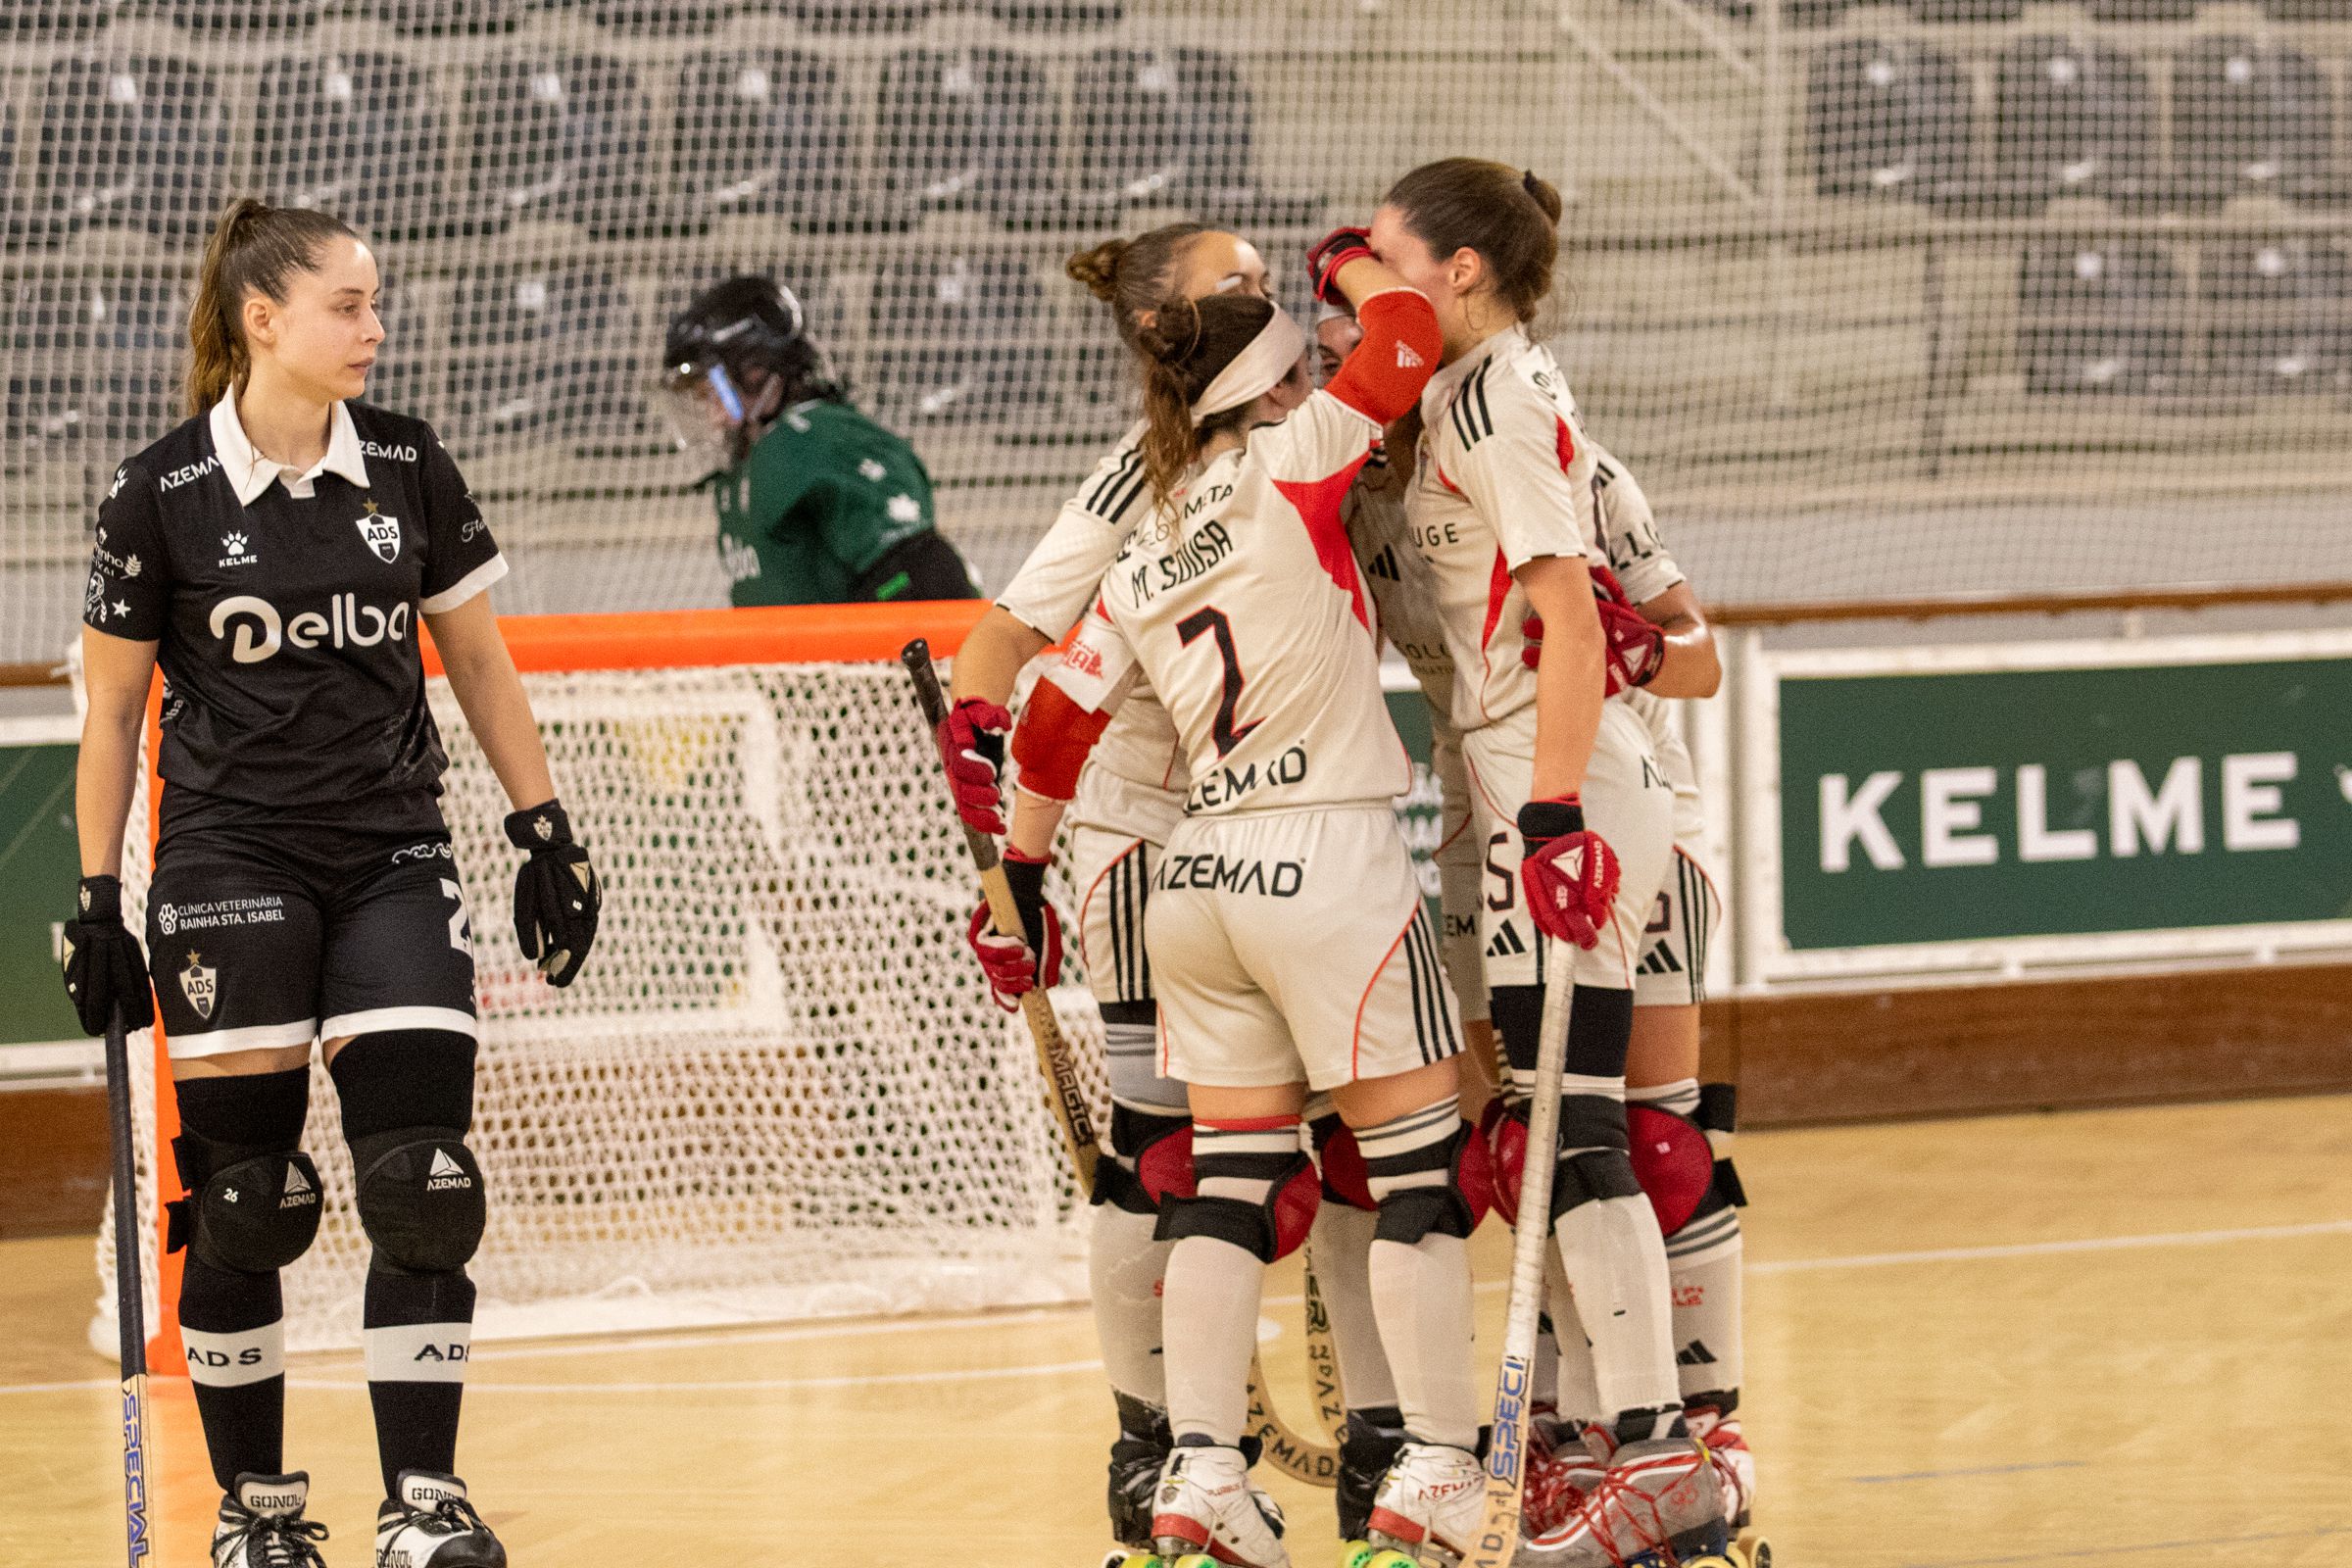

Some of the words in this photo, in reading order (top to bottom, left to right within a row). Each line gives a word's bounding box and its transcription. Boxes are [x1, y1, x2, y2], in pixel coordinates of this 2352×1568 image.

[367, 526, 398, 542] ADS
[219, 555, 258, 568] KELME
[1158, 519, 1233, 591] SOUSA
[1175, 605, 1268, 761] 2
[1818, 751, 2301, 873] KELME
[177, 902, 215, 916] CLÍNICA
[215, 896, 284, 912] VETERINÁRIA
[180, 915, 220, 930] RAINHA
[220, 913, 246, 926] STA.
[247, 909, 285, 923] ISABEL
[187, 979, 214, 995] ADS
[1049, 1047, 1095, 1145] MAGIC
[426, 1177, 471, 1192] AZEMAD
[223, 1188, 239, 1203] 26
[279, 1193, 316, 1209] AZEMAD
[187, 1347, 263, 1367] ADS
